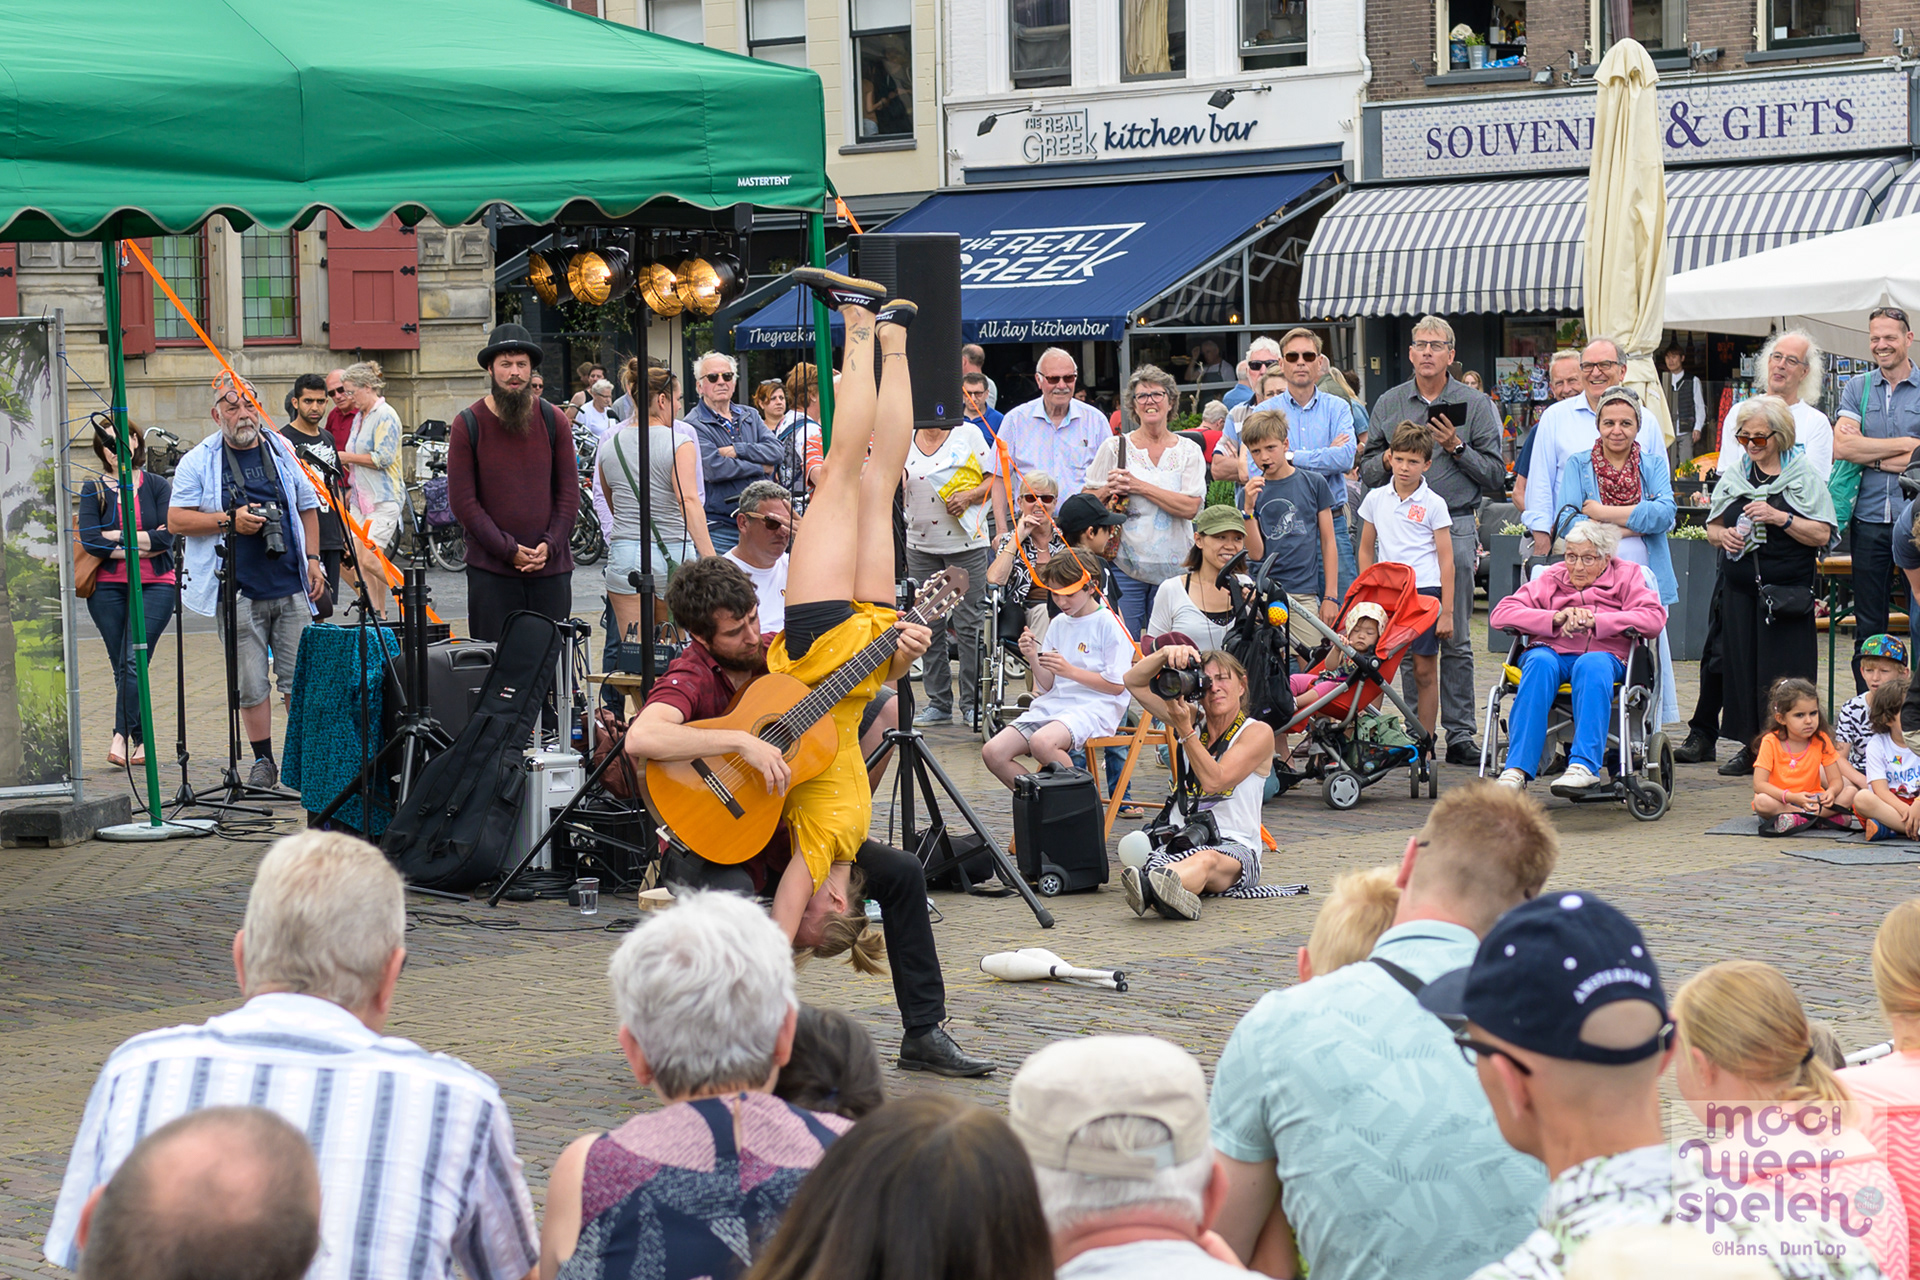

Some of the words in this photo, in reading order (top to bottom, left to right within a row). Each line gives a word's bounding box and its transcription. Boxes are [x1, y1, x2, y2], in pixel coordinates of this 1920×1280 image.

[1024, 117, 1042, 130] THE
[1045, 115, 1083, 133] REAL
[1103, 117, 1206, 151] kitchen
[1208, 113, 1258, 144] bar
[1426, 117, 1595, 161] SOUVENI
[1665, 100, 1712, 149] &
[1722, 98, 1854, 141] GIFTS
[737, 175, 791, 187] MASTERTENT
[960, 236, 1006, 251] THE
[994, 232, 1105, 255] REAL
[978, 320, 1000, 339] All
[1001, 320, 1029, 342] day
[1031, 318, 1110, 337] kitchenbar
[245, 466, 265, 480] FUT
[1573, 967, 1652, 1005] AMSTERDAM
